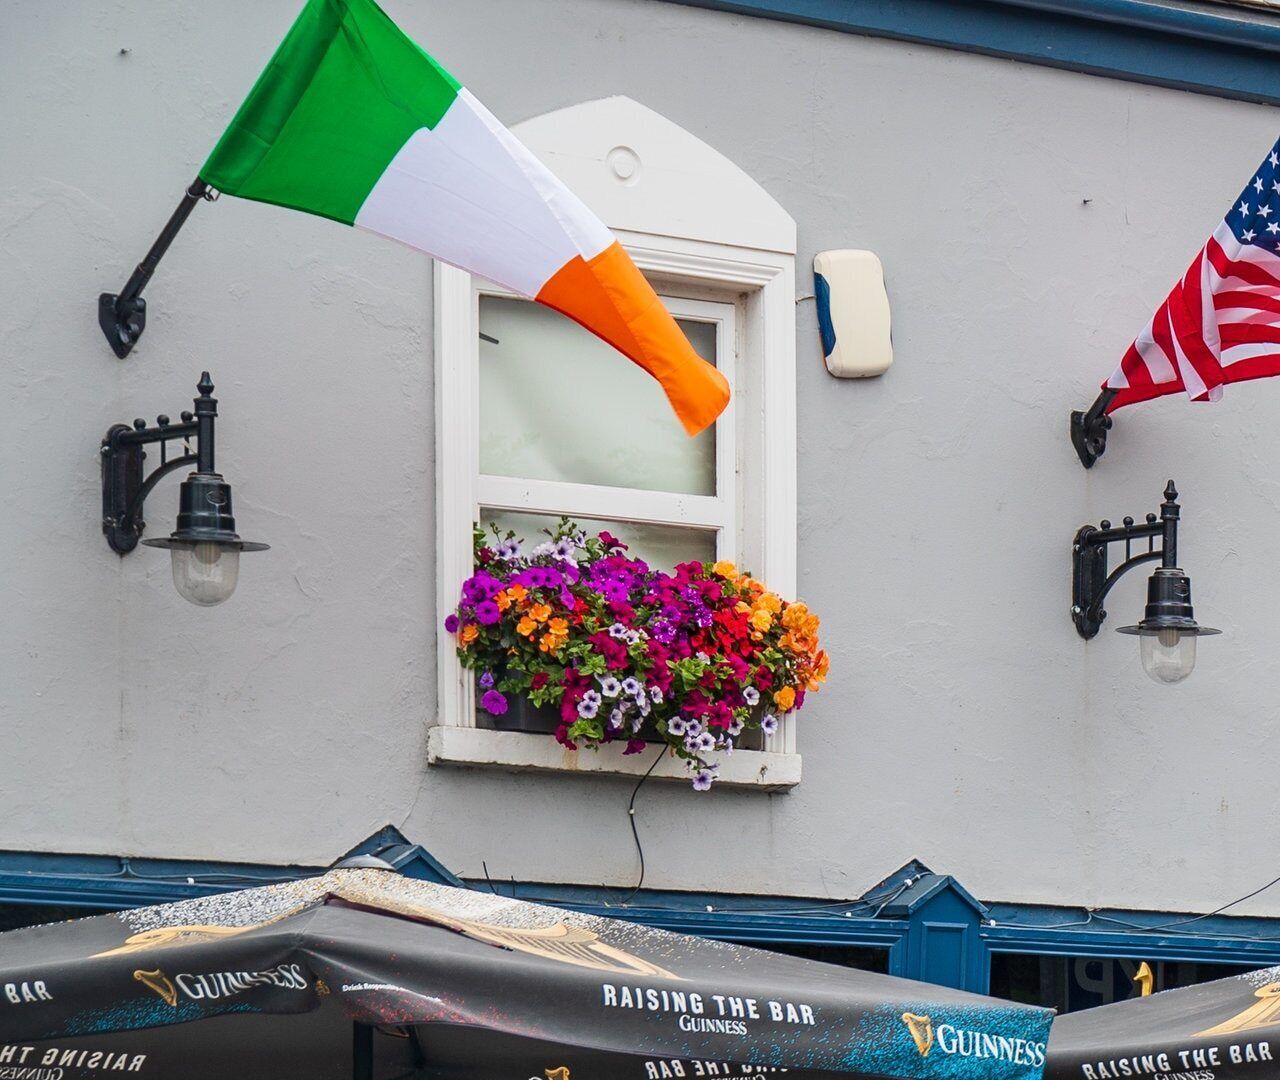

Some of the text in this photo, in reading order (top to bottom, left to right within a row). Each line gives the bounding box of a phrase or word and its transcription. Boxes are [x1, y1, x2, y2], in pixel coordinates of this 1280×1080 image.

[4, 979, 53, 1004] BAR
[175, 963, 308, 1001] GUINNESS
[602, 983, 817, 1026] RAISING THE BAR
[679, 1014, 747, 1036] GUINNESS
[937, 1024, 1046, 1069] GUINNESS
[1081, 1041, 1273, 1080] RAISING THE BAR
